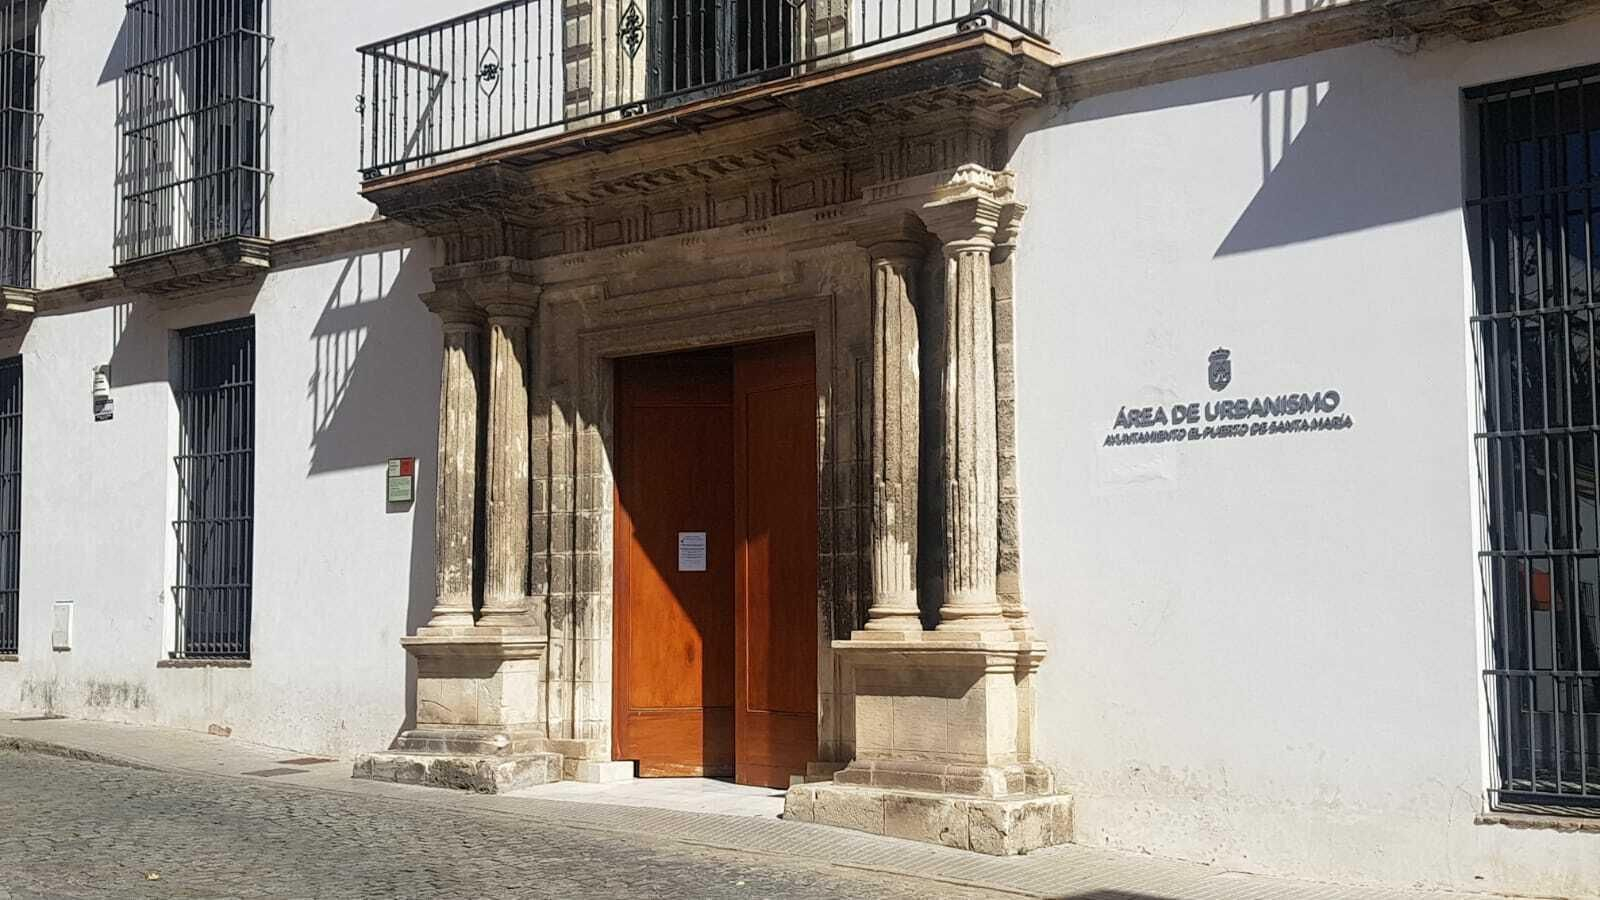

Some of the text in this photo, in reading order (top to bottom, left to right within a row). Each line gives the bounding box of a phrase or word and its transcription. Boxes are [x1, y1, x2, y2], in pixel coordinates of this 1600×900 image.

[1113, 390, 1341, 429] ÁREA DE URBANISMO
[1103, 413, 1353, 447] AYUNTAMIENTO EL PUERTO DE SANTA MARÍA
